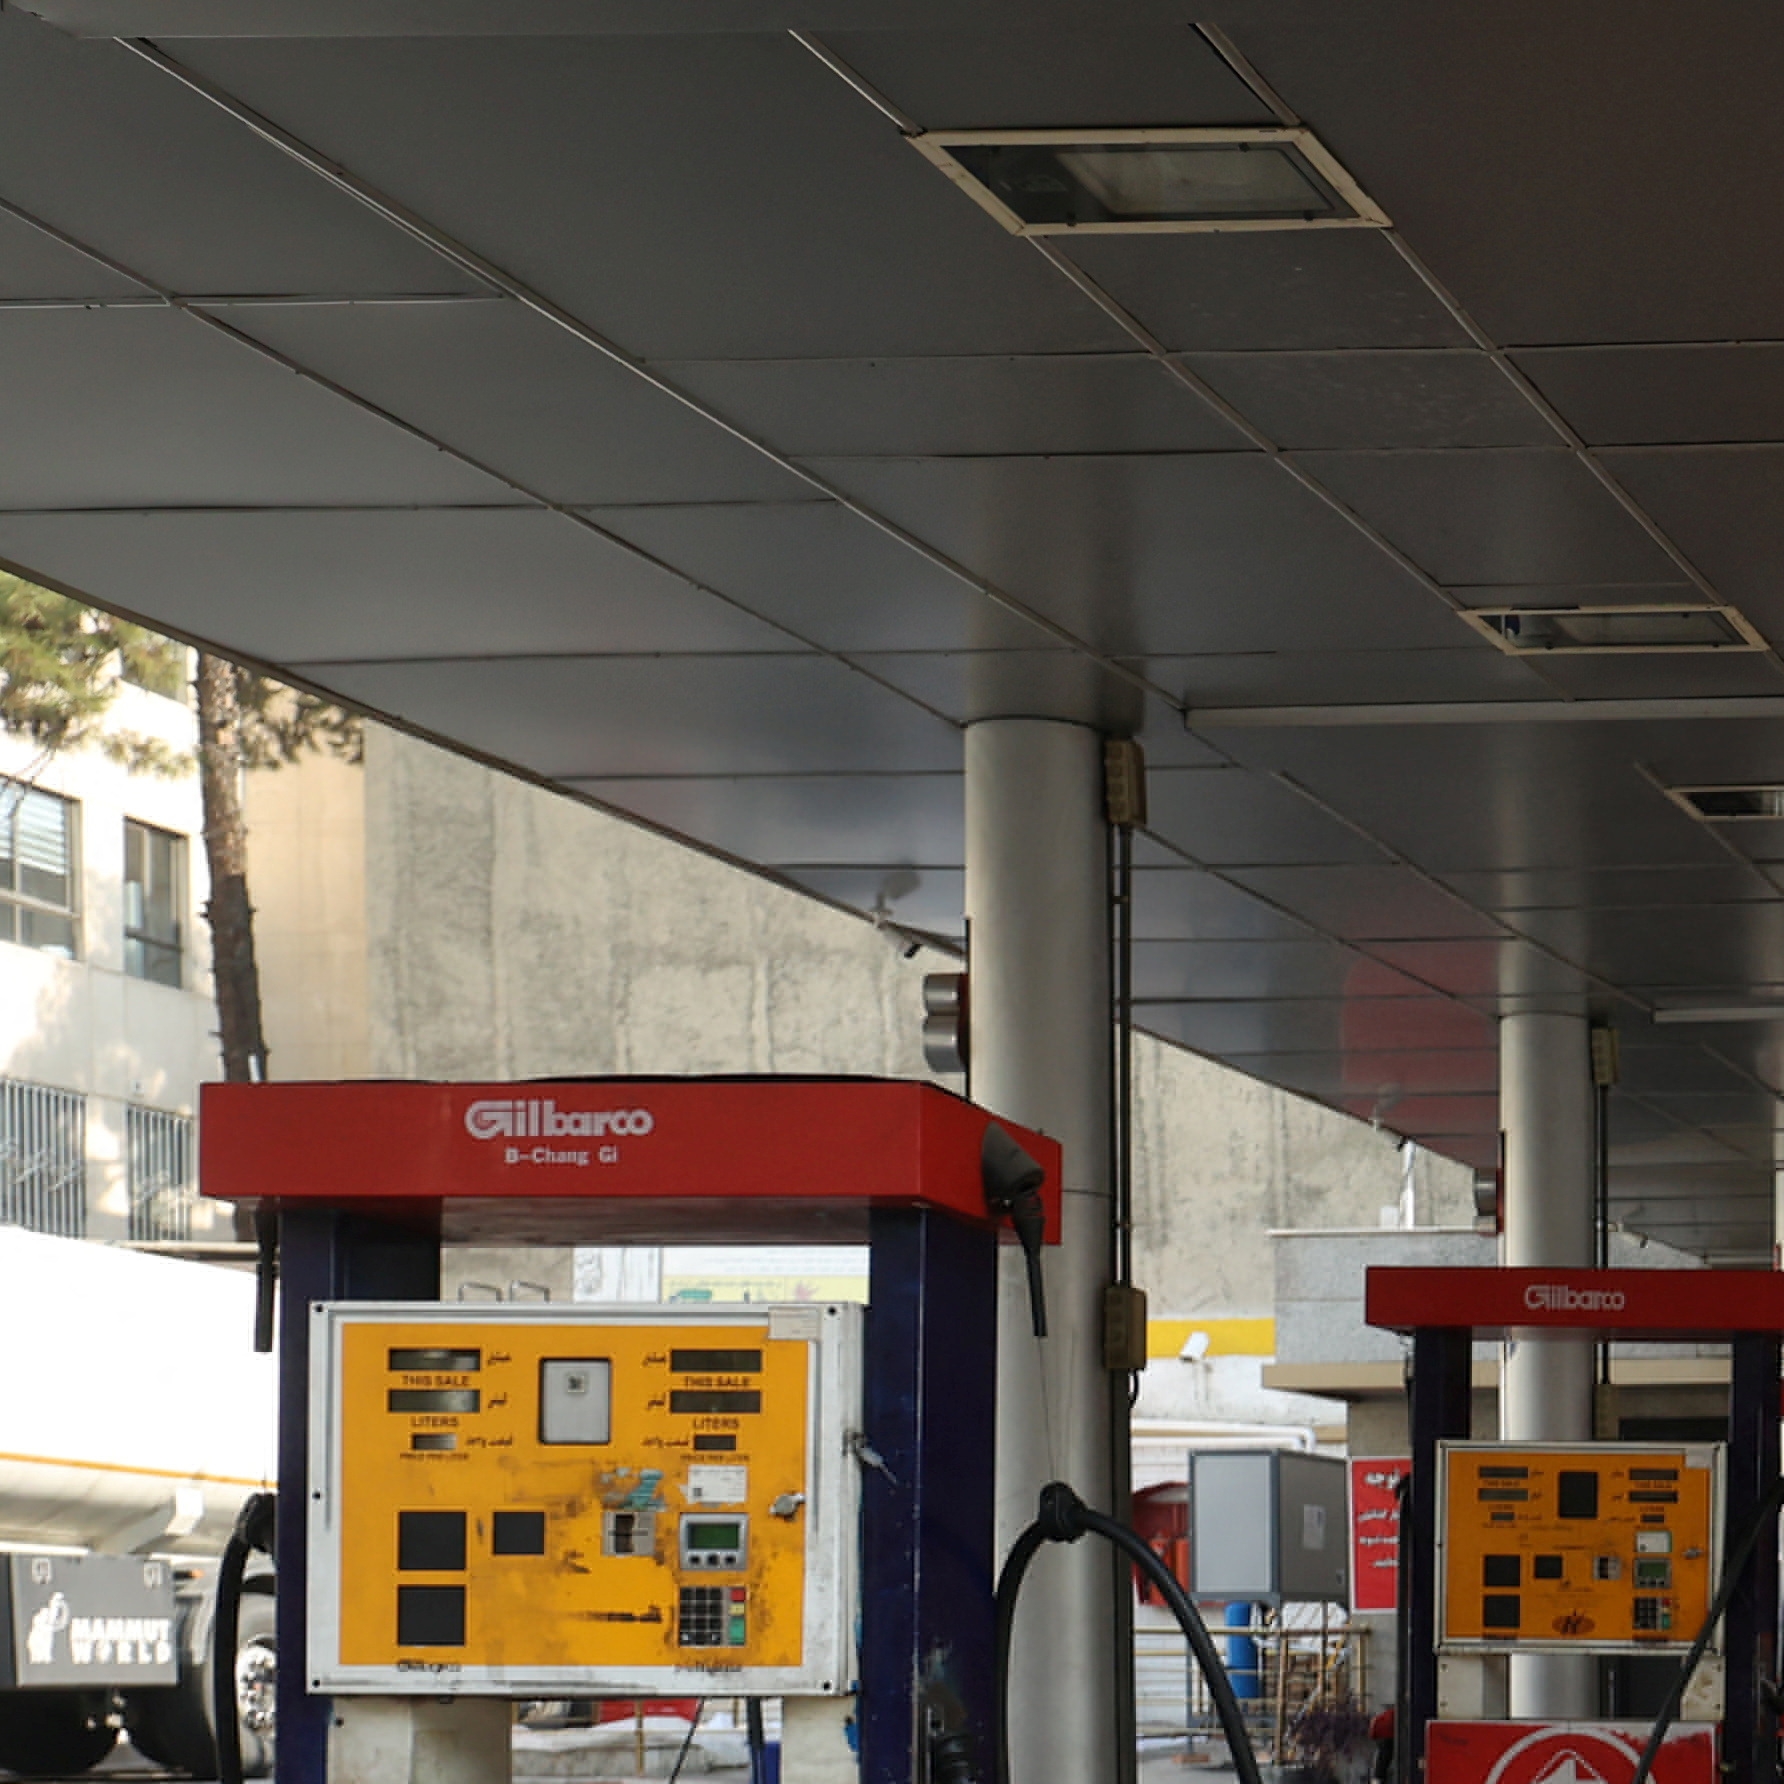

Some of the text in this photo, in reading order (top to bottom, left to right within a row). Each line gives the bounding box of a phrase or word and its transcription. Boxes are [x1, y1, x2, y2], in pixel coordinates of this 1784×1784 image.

[464, 1099, 654, 1139] Gilbarco
[504, 1147, 590, 1166] B-Chang
[1525, 1284, 1625, 1310] Gilbarco
[401, 1375, 469, 1386] THIS SALE
[684, 1376, 750, 1387] THIS SALE
[410, 1415, 458, 1428] LITERS
[693, 1417, 740, 1429] LITERS
[71, 1617, 170, 1640] MAMMUT
[71, 1641, 171, 1664] WORLD
